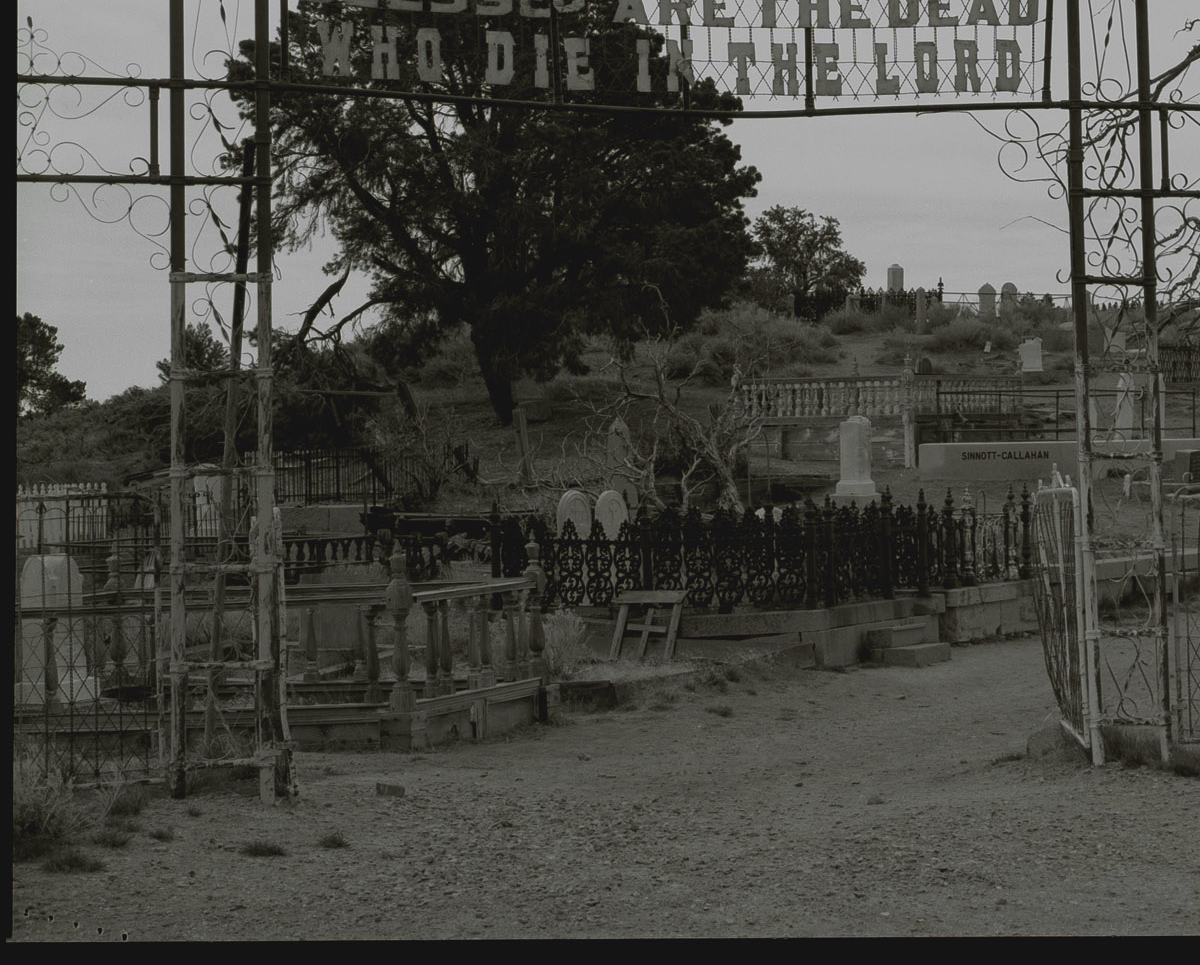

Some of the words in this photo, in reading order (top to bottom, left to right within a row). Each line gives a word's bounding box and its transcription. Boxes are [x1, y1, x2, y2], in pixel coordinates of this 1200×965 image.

[316, 21, 443, 83] WHO
[485, 30, 595, 91] DIE
[636, 38, 694, 93] IN
[727, 42, 842, 96] THE
[875, 39, 1022, 96] LORD
[961, 450, 1049, 461] SINNOTT-CALLAHAN
